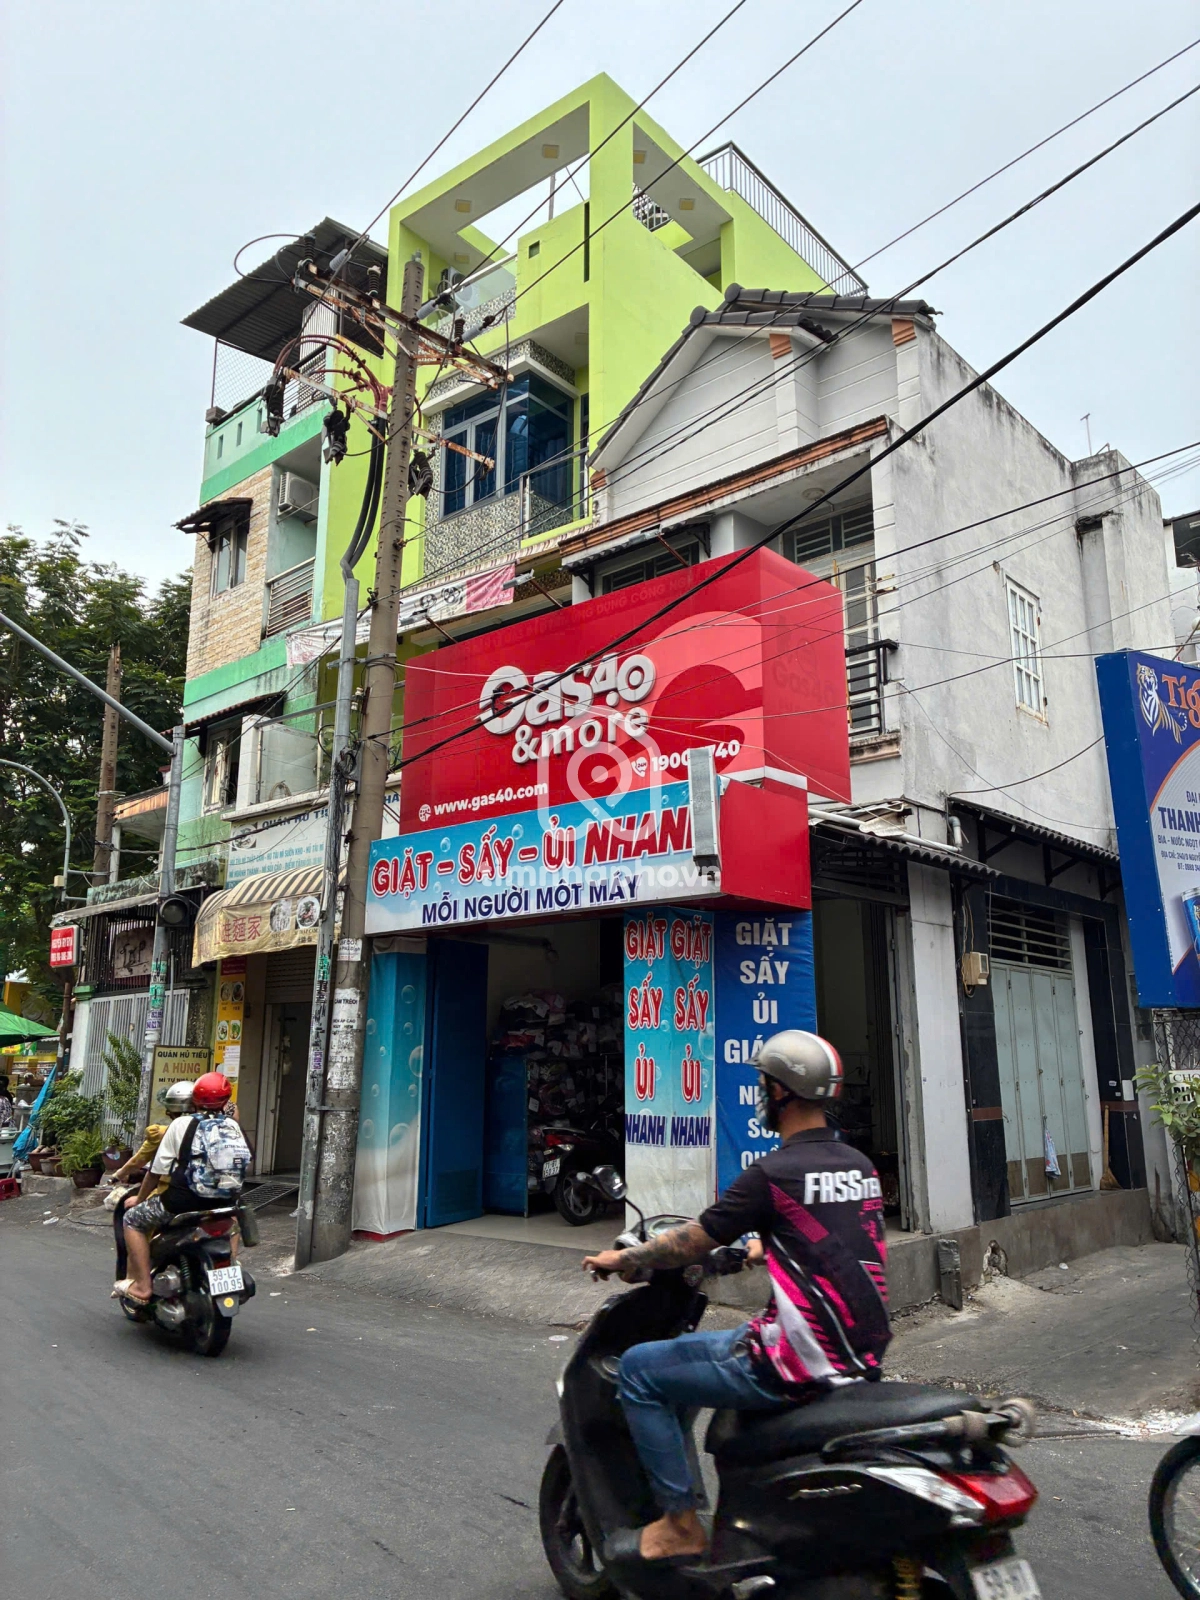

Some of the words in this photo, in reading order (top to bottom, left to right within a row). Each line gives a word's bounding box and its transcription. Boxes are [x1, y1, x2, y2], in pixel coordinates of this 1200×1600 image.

[434, 783, 548, 816] www.gas40.com
[372, 848, 433, 898] GIẶT
[458, 825, 514, 885] SẤY
[542, 814, 576, 872] ỦI
[583, 805, 692, 867] NHAN
[422, 891, 459, 925] MỖI
[464, 885, 530, 920] NGƯỜI
[536, 878, 583, 912] MỘT
[590, 869, 641, 905] MÁY
[625, 911, 667, 967] GIẶT
[670, 914, 713, 969] GIẶT
[735, 918, 792, 950] GIẶT
[740, 953, 790, 985] SẤY
[628, 971, 663, 1030] SẤY
[674, 973, 710, 1031] SẤY
[752, 992, 778, 1024] ỦI
[157, 1050, 178, 1058] QUÁN
[163, 1063, 169, 1073] A
[172, 1060, 201, 1074] HÙNG
[635, 1041, 656, 1102] ỦI
[681, 1043, 702, 1103] ỦI
[625, 1114, 667, 1147] NHANH
[670, 1116, 711, 1148] NHANH
[211, 1278, 242, 1294] 100.95
[212, 1268, 238, 1281] 59-L2
